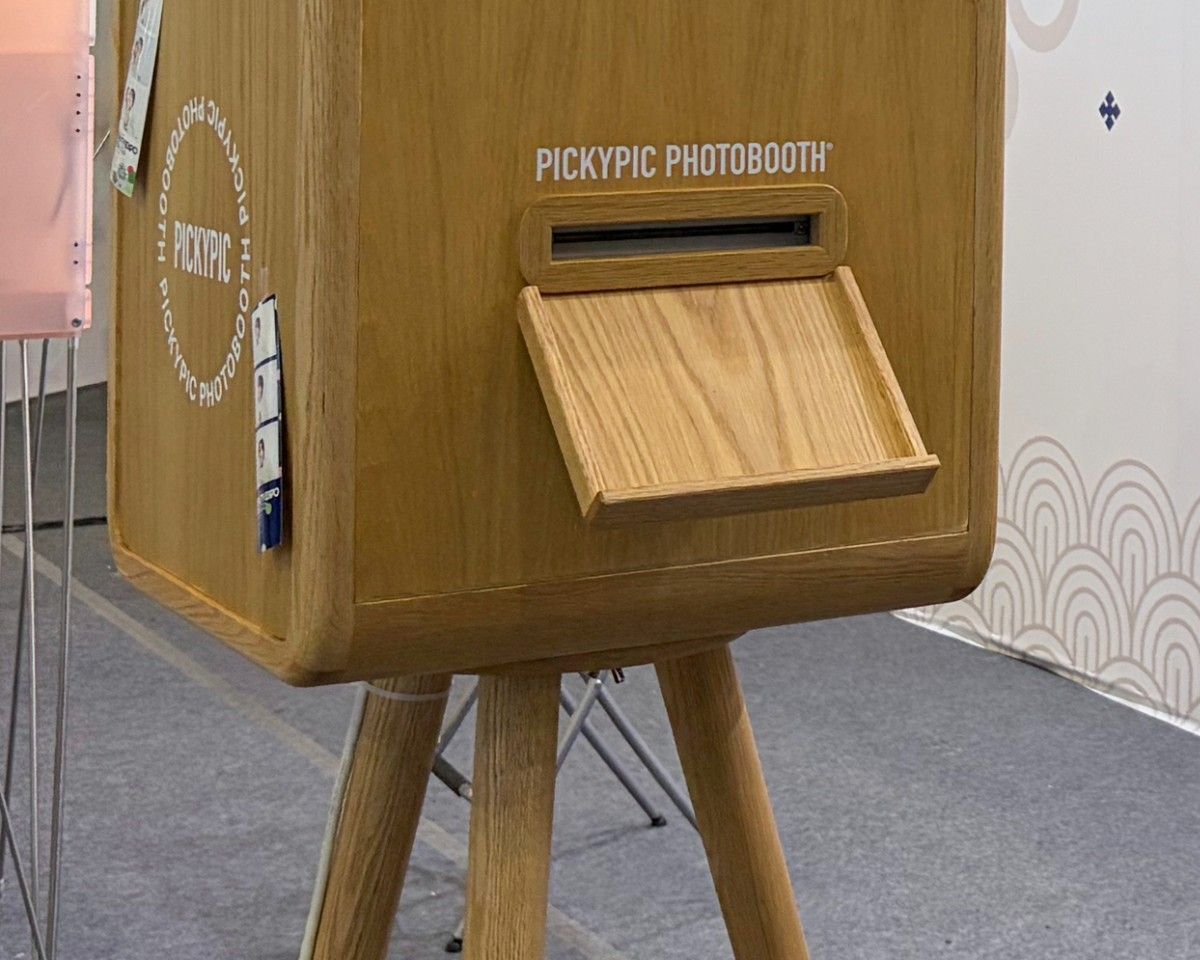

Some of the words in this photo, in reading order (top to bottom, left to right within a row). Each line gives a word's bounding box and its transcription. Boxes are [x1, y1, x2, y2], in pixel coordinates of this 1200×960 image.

[157, 96, 205, 262] PHOTOBOOTH
[536, 145, 657, 182] PICKYPIC
[174, 220, 231, 284] PICKYPIC
[200, 238, 250, 407] PHOTOBOOTH
